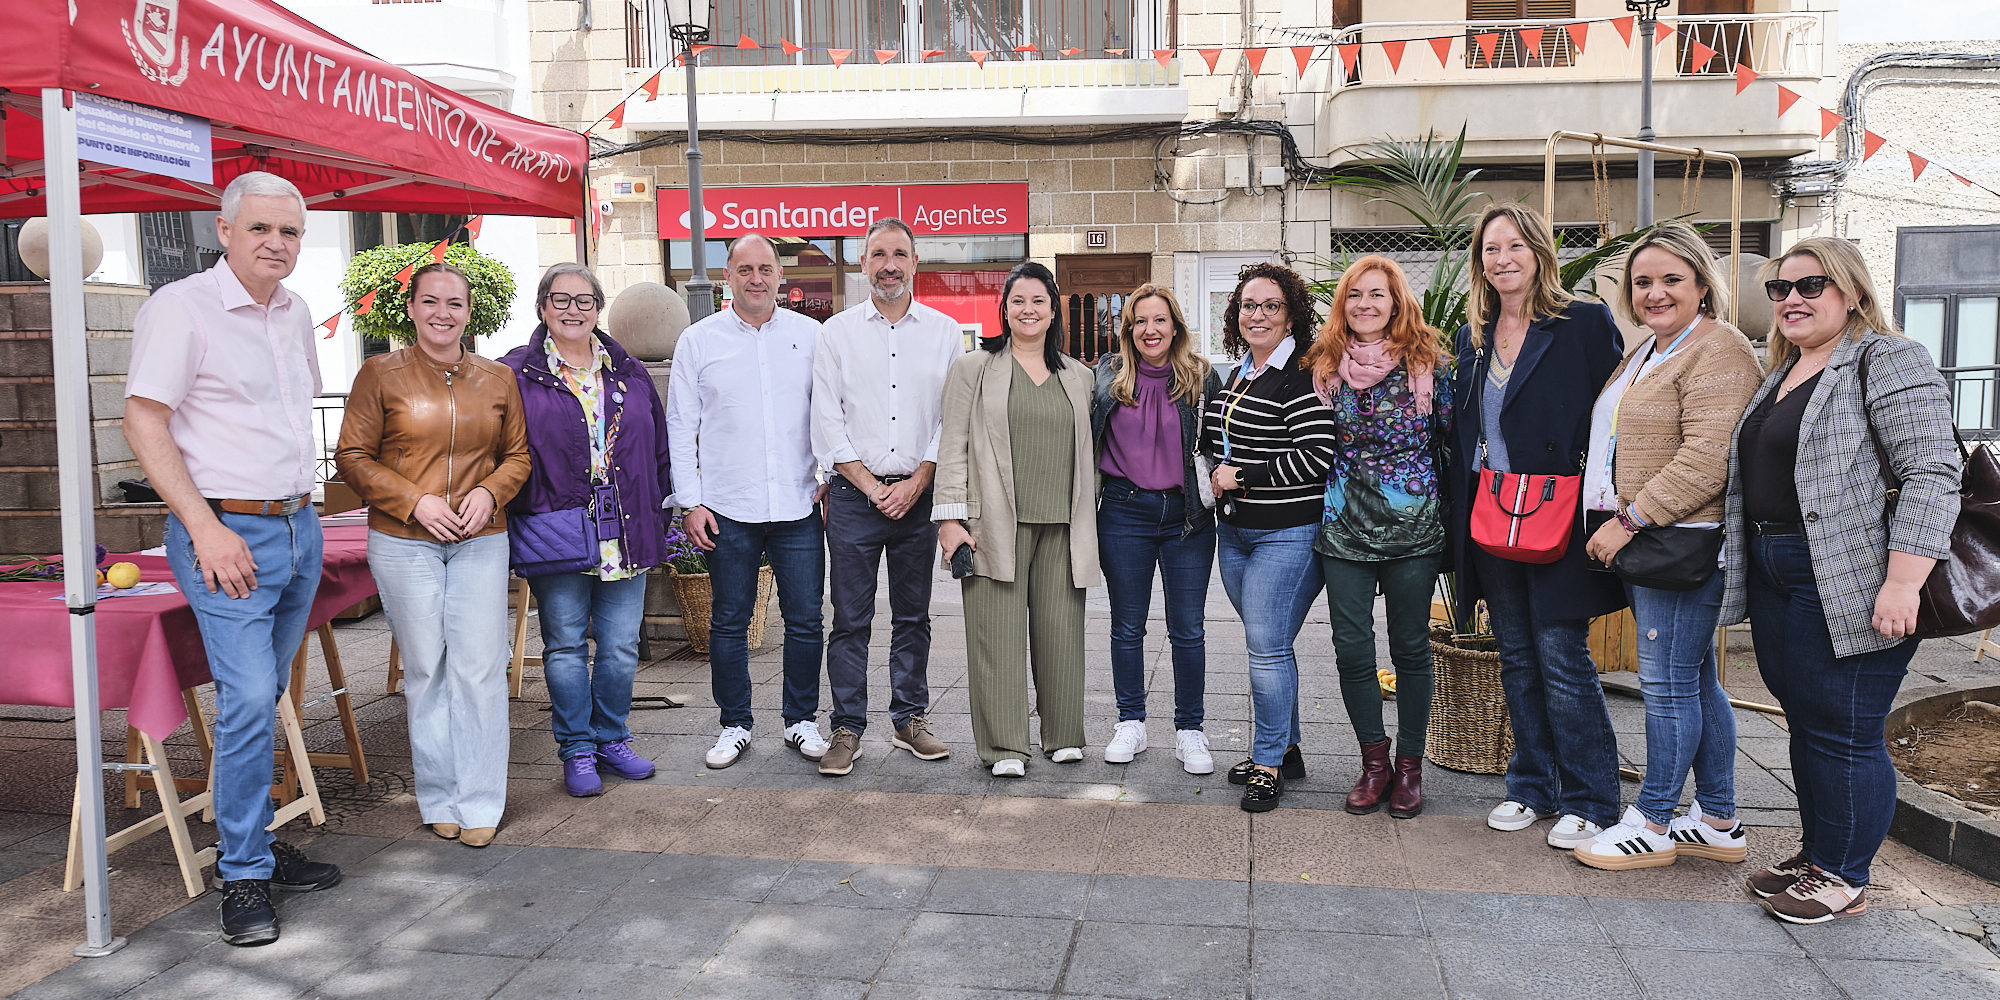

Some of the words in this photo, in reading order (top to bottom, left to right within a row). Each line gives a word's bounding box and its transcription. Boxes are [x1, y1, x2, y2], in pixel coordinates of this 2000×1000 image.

[200, 22, 466, 148] AYUNTAMIENTO
[467, 120, 502, 163] DE
[76, 102, 127, 124] Igualdad
[127, 116, 135, 126] y
[135, 117, 192, 139] Diversidad
[170, 113, 184, 124] de
[77, 117, 96, 130] del
[97, 121, 140, 140] Cabildo
[141, 132, 156, 144] de
[156, 135, 200, 153] Tenerife
[78, 137, 113, 151] PUNTO
[113, 144, 126, 154] DE
[127, 147, 191, 168] INFORMACIÓN
[722, 201, 880, 229] Santander
[913, 204, 1008, 231] Agentes
[1091, 234, 1103, 244] 16
